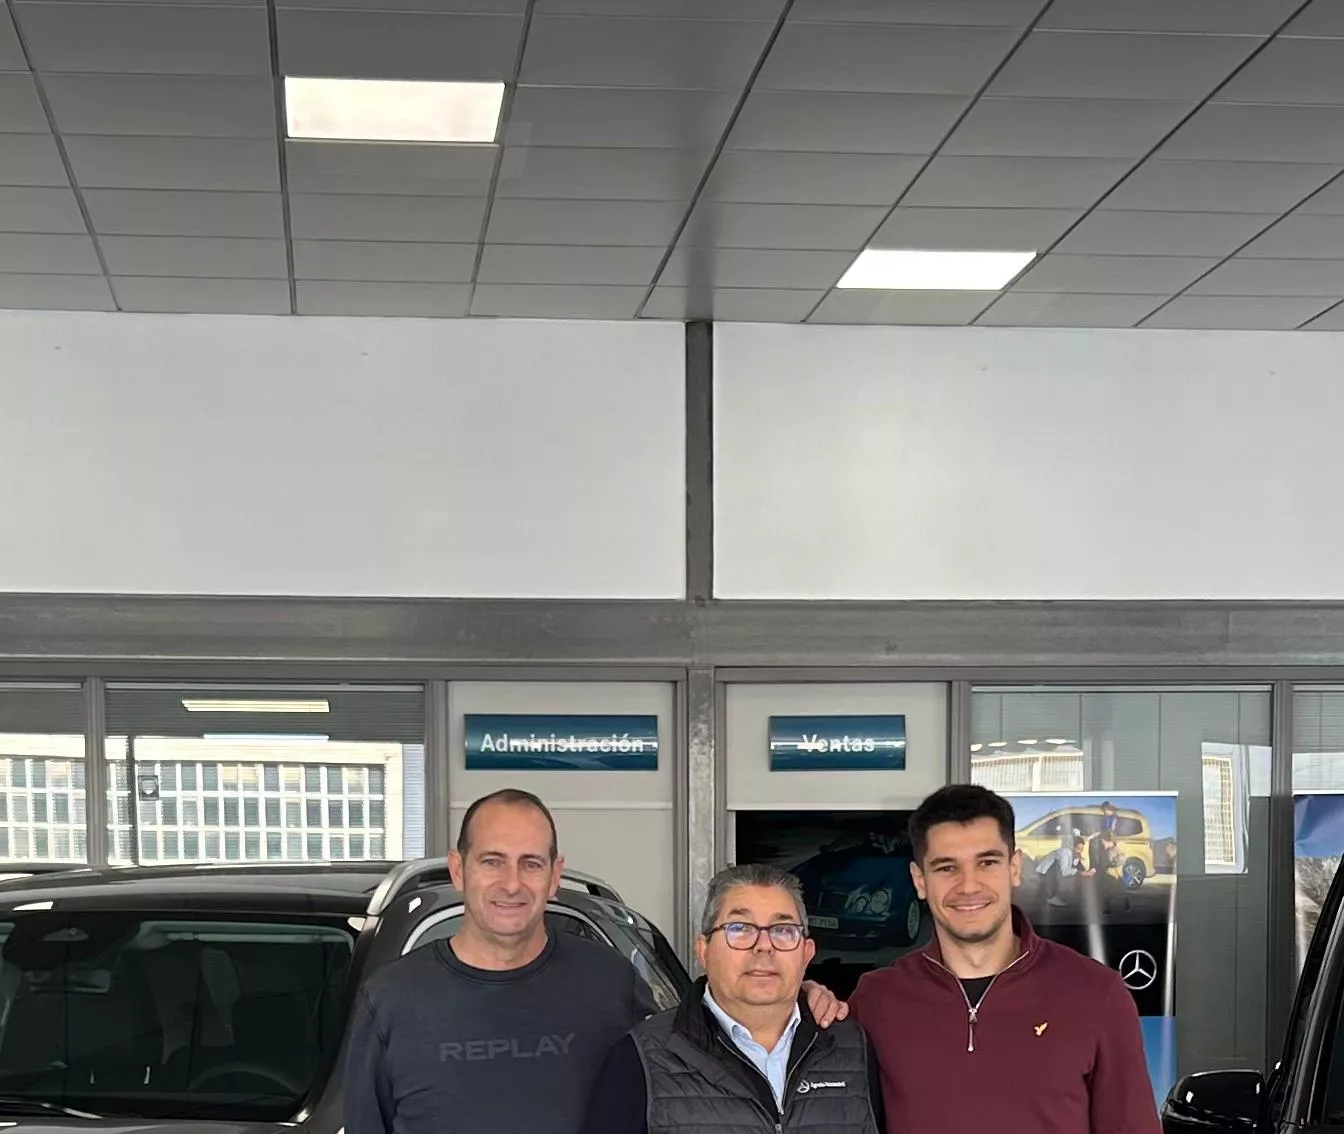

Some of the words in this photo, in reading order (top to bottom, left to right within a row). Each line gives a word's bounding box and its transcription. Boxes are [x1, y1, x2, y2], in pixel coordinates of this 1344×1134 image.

[480, 733, 644, 752] Administración
[801, 734, 875, 752] Ventas
[439, 1032, 576, 1062] REPLAY
